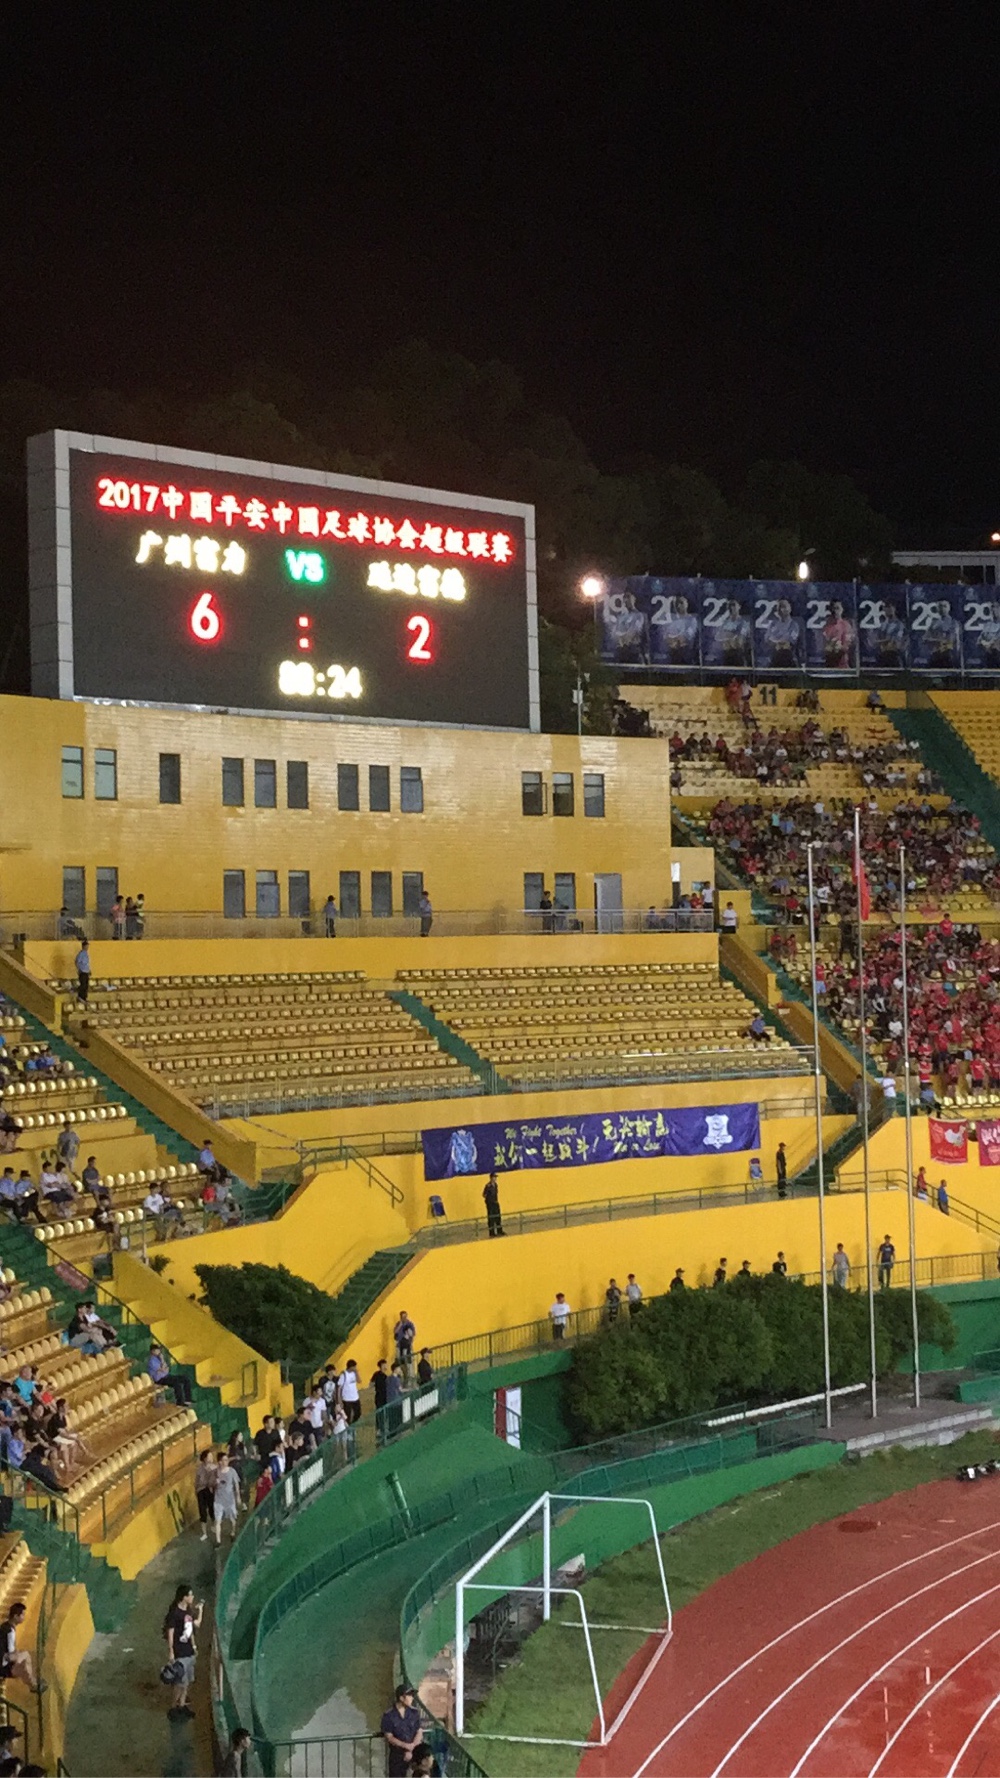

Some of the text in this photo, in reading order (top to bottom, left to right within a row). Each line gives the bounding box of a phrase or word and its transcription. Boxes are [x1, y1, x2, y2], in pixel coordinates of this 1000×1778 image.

[98, 478, 512, 562] 2017中国平安中国足球协会超级联赛
[285, 549, 325, 583] VS
[191, 592, 220, 640] 6
[407, 615, 432, 659] 2
[760, 686, 777, 705] 11
